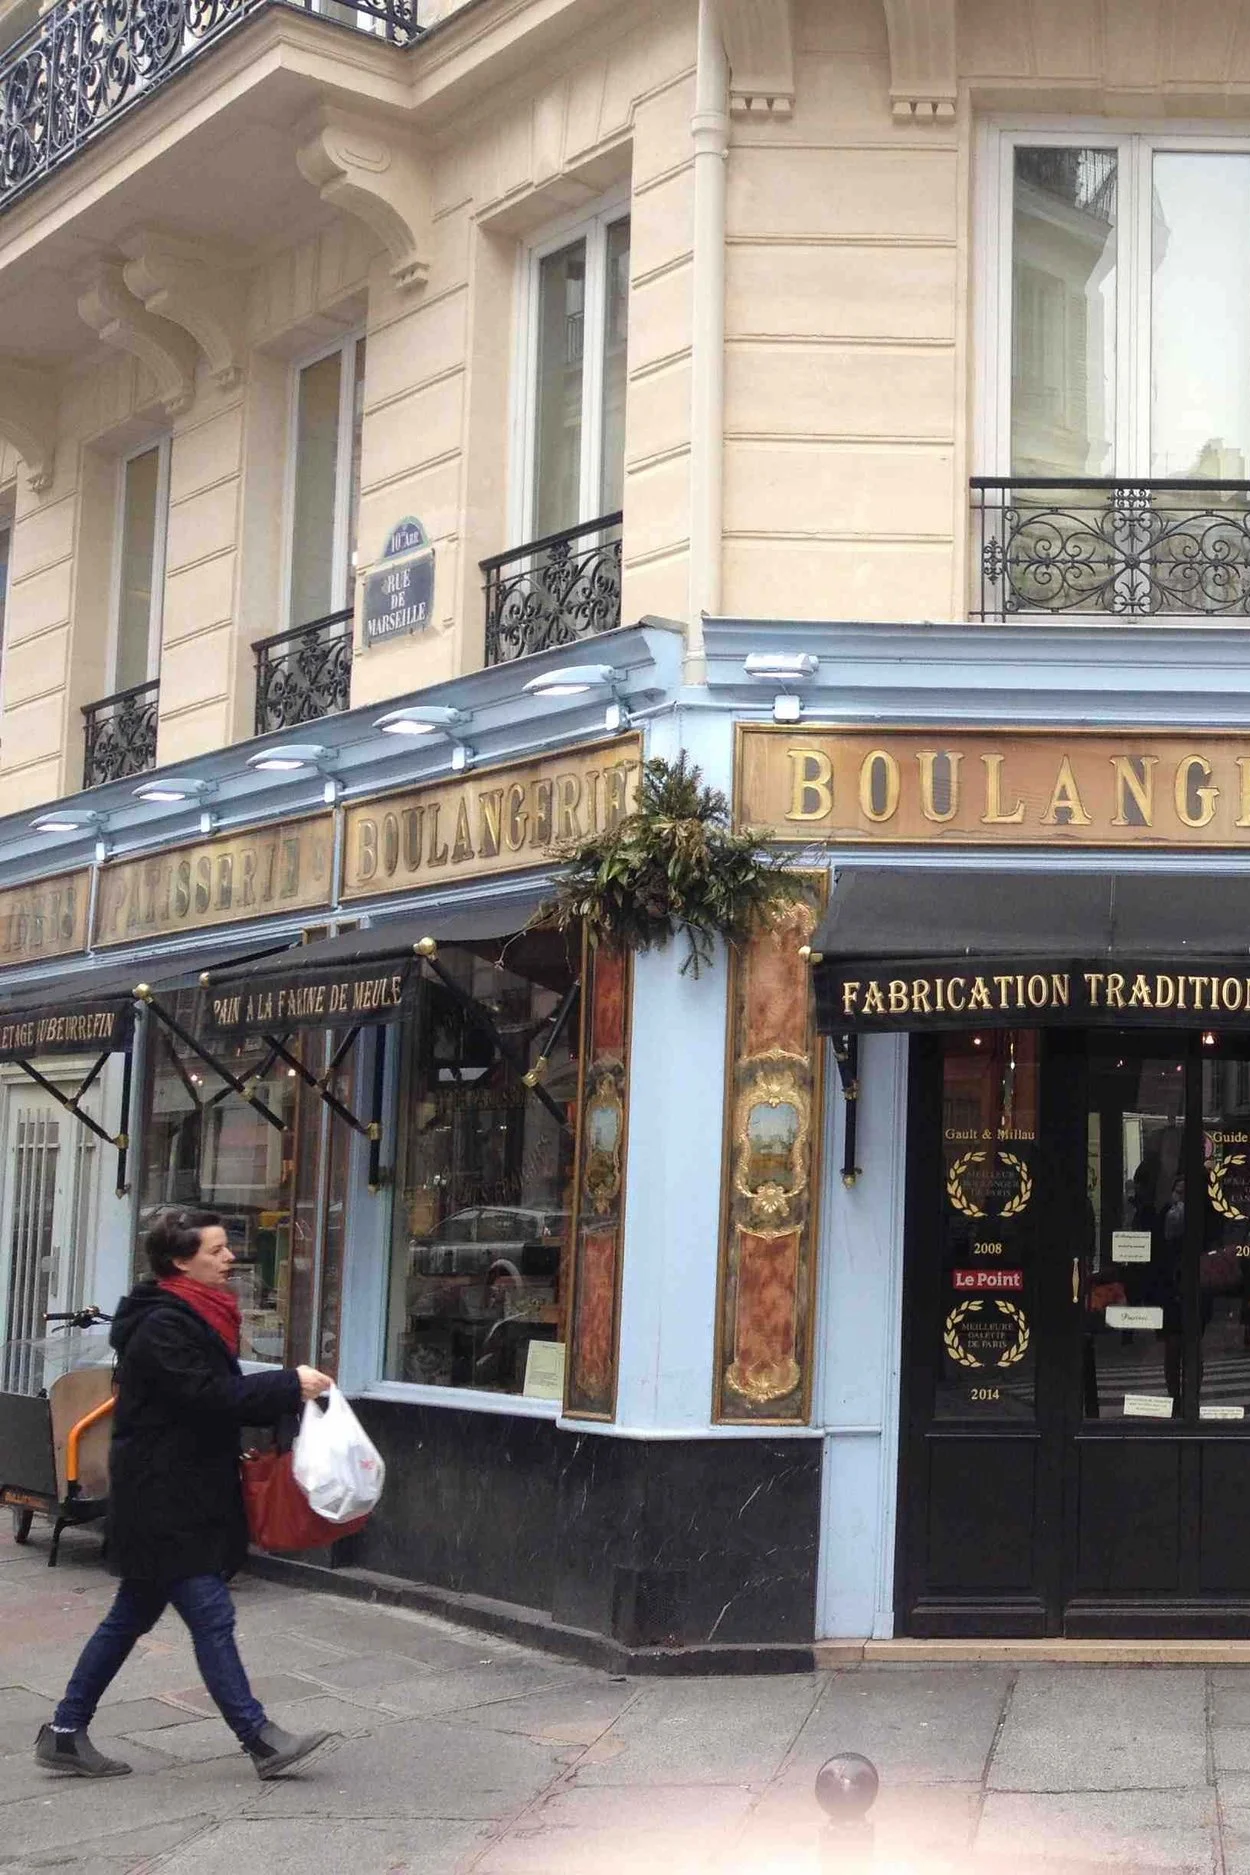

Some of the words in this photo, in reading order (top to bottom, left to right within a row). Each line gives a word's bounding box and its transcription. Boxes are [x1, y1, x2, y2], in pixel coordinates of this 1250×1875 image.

[387, 568, 411, 593] RUE
[390, 591, 405, 610] DE
[368, 602, 426, 637] MARSEILLE
[356, 759, 638, 882] BOULANGERIE
[213, 997, 240, 1026] PAIN
[257, 991, 272, 1021] LA
[329, 983, 349, 1013] DE
[351, 976, 402, 1011] MEULE
[841, 973, 1071, 1016] FABRICATION
[945, 1128, 978, 1141] Gault
[982, 1129, 993, 1141] &
[997, 1128, 1035, 1141] Millau
[1213, 1131, 1249, 1143] Guide
[973, 1242, 1003, 1255] 2008
[956, 1273, 976, 1287] Le
[977, 1271, 1021, 1287] Point
[971, 1389, 1000, 1401] 2014
